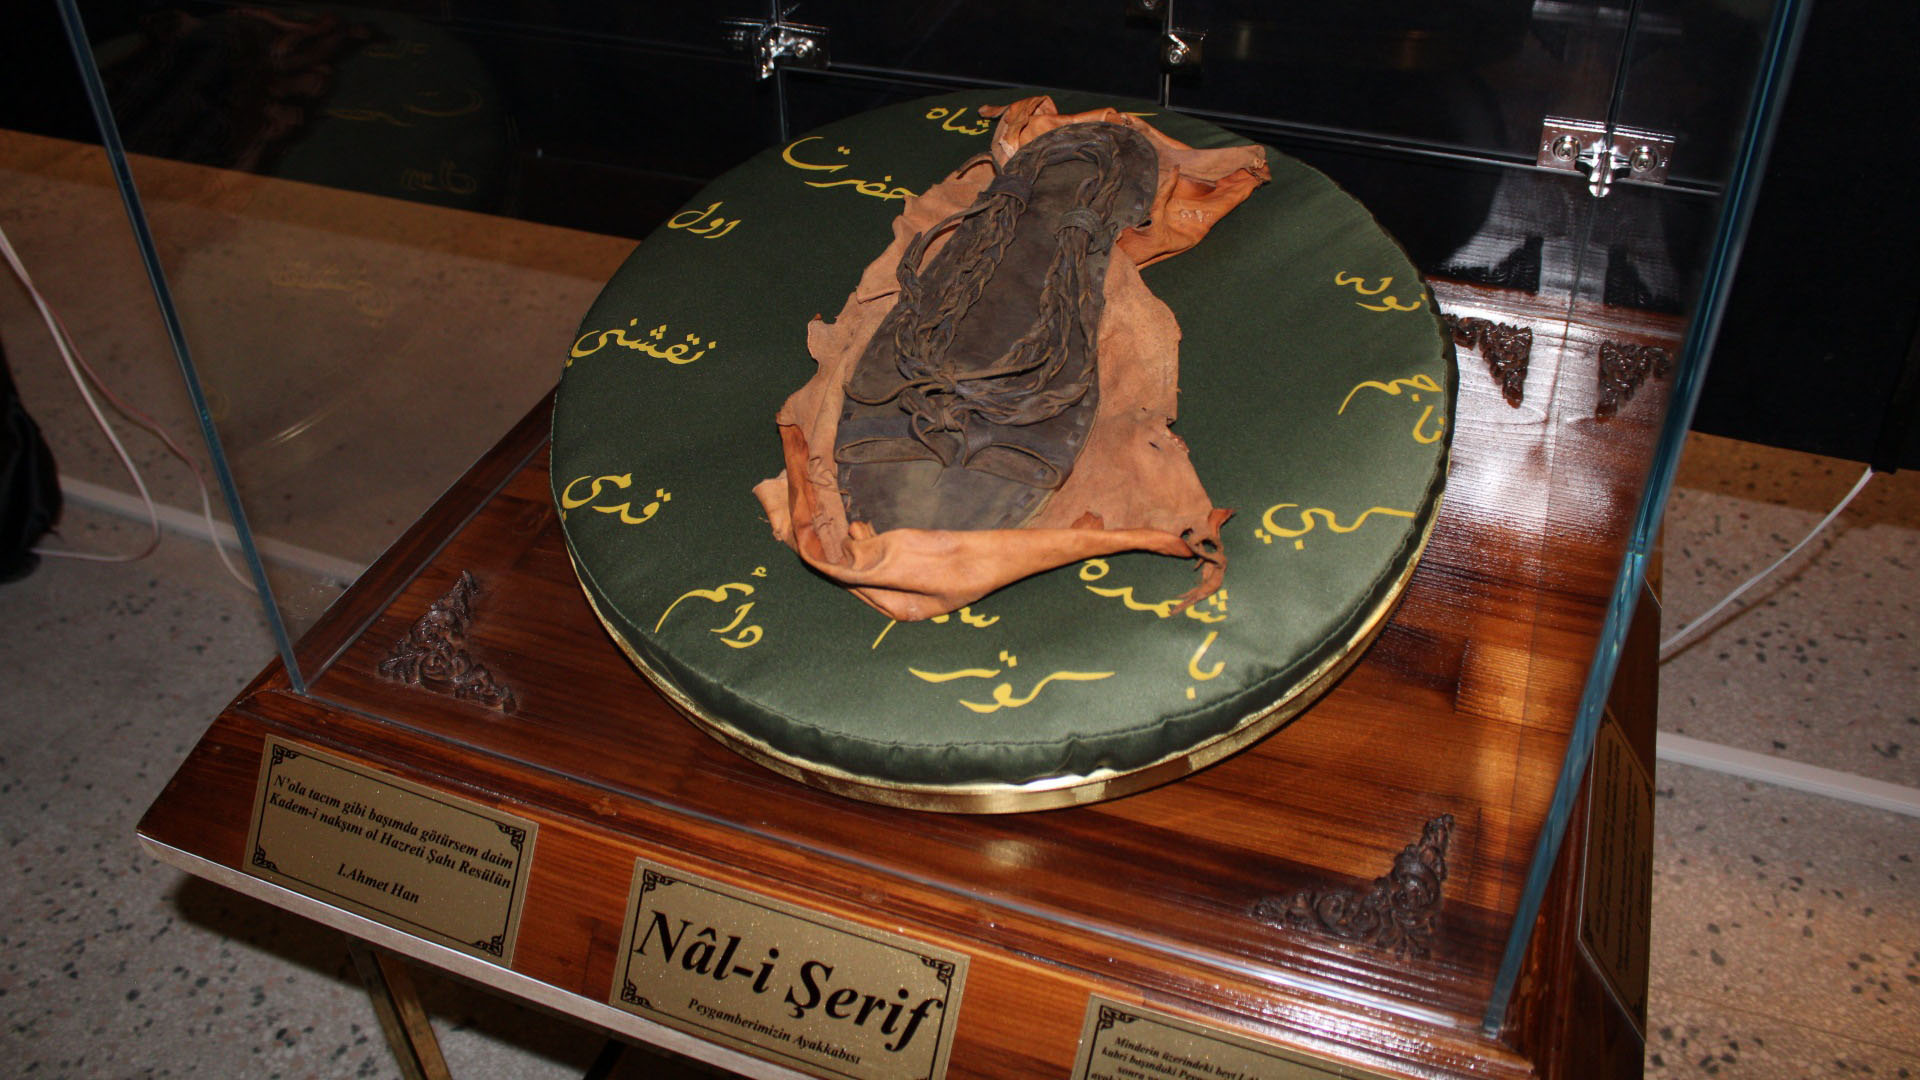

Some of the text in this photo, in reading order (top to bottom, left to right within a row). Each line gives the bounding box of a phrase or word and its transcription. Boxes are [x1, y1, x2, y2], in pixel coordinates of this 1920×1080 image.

[269, 792, 512, 889] Kadem-i nakşını ol Hazreti Şahı Resülün
[308, 789, 341, 808] tacım
[342, 801, 367, 818] gibi
[369, 808, 418, 836] başımda
[419, 828, 478, 858] götürsem
[481, 849, 513, 870] daim
[337, 863, 419, 904] I.Ahmet Han
[634, 910, 944, 1053] Nâl-i Şerif
[687, 997, 862, 1066] Peygamberimizin Ayakkabısı
[1114, 1037, 1160, 1058] Minderin
[1162, 1051, 1214, 1074] üzerindeki
[1129, 1055, 1178, 1077] başındaki
